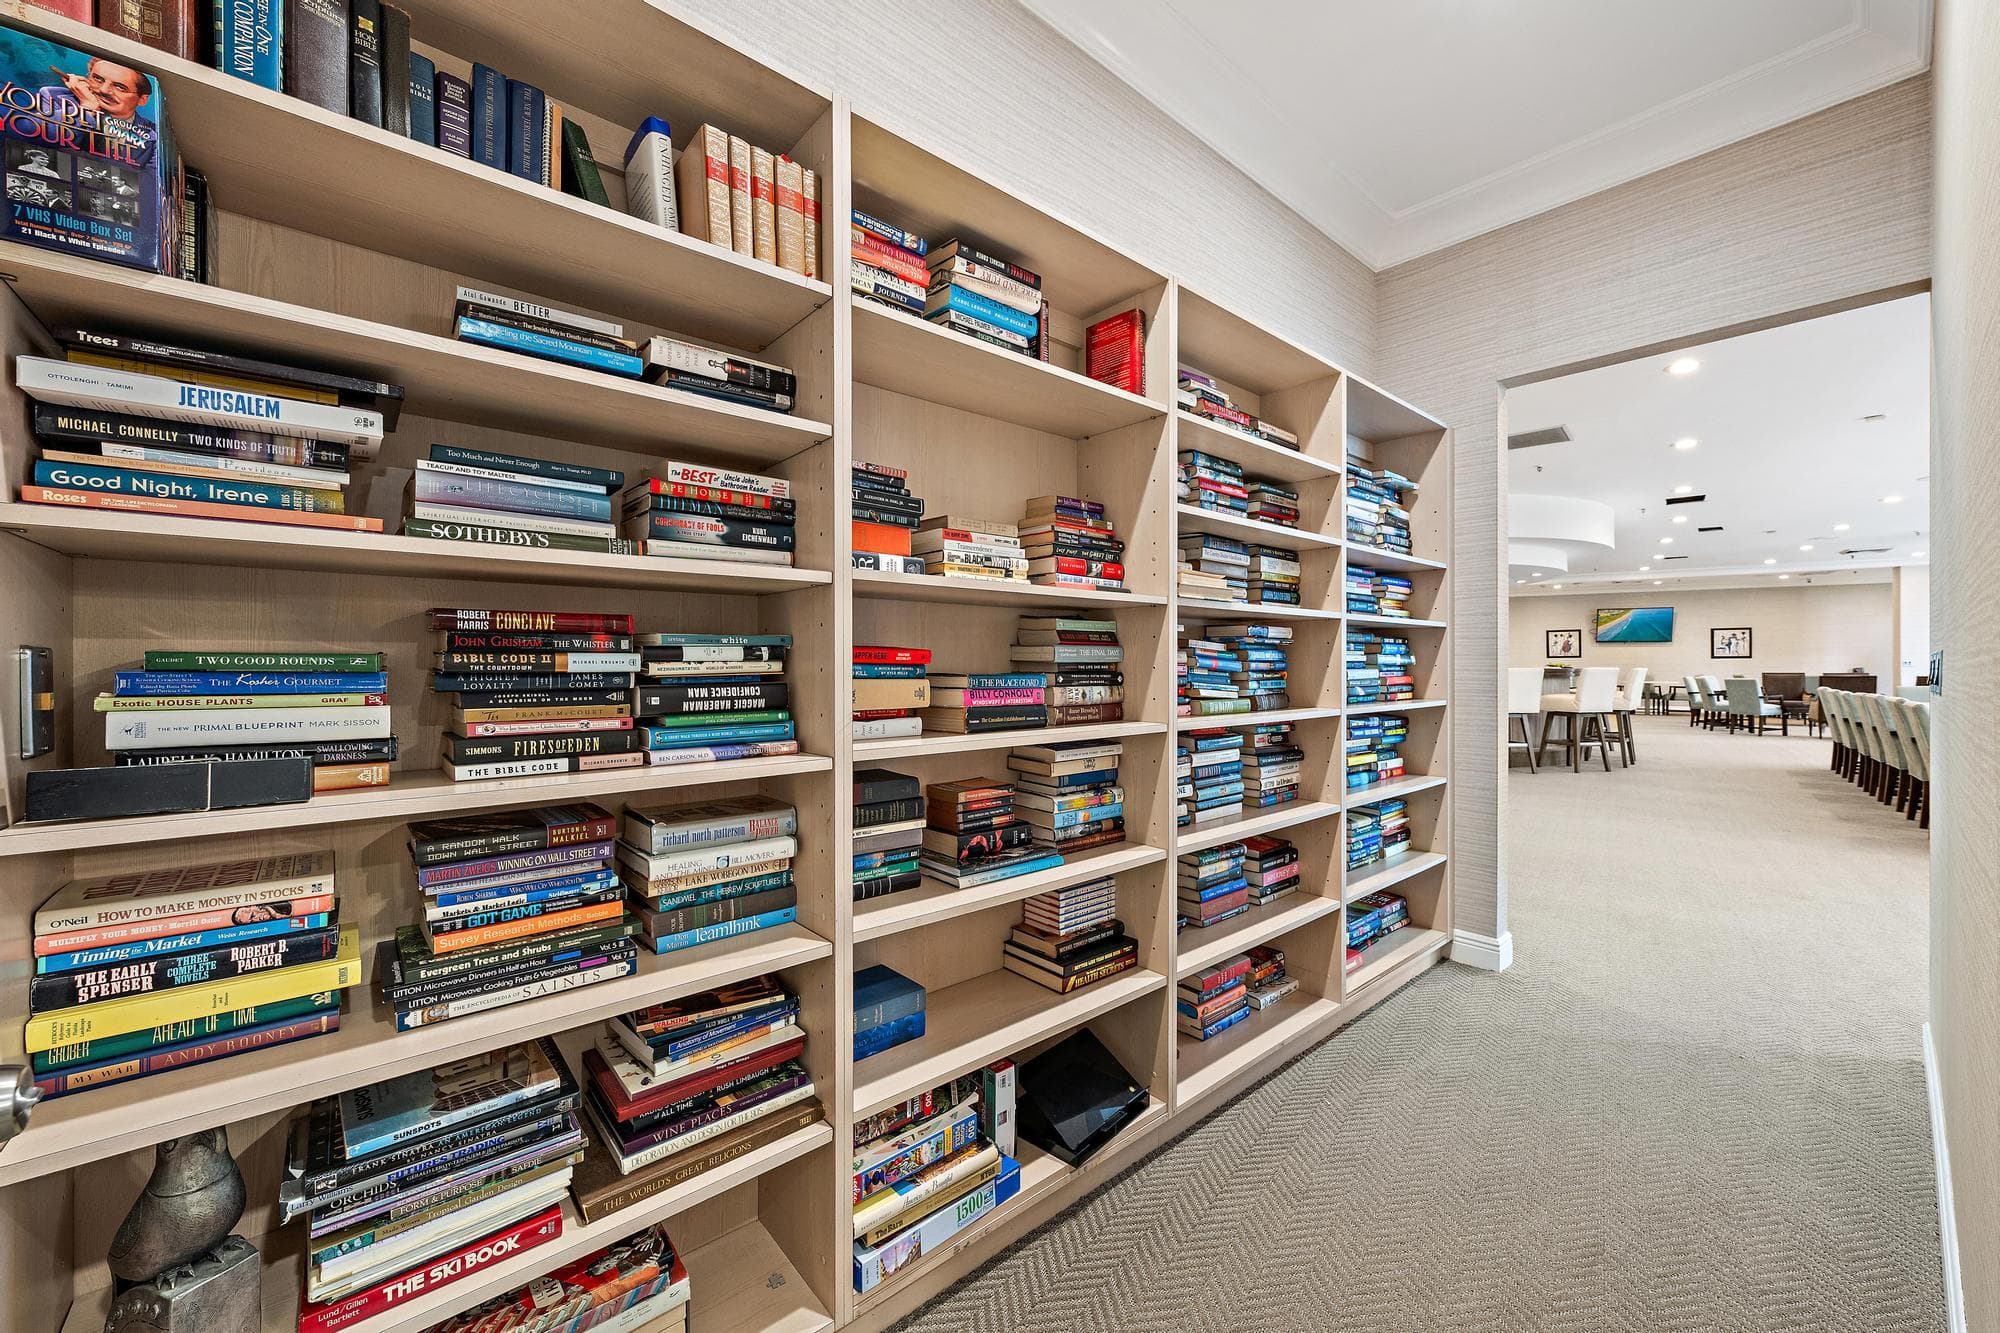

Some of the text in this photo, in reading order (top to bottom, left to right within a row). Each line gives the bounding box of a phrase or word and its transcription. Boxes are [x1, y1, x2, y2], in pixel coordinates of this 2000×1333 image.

[234, 1, 254, 76] COMPANION
[354, 30, 378, 44] HOLY
[0, 82, 104, 131] YOU BET
[105, 116, 151, 140] GROUCHO
[109, 126, 146, 149] MARX
[658, 137, 672, 203] UNHINGED
[13, 203, 133, 243] 7 VHS Video Box Set
[854, 211, 903, 238] BLOCKBUSTER
[864, 237, 925, 269] PRIMARY COLORS
[865, 265, 908, 288] POWELL
[879, 286, 908, 304] JOURNEY
[954, 296, 970, 307] CAROL
[513, 301, 550, 319] BETTER
[57, 416, 297, 458] MICHAEL CONNELLY TWO KINDS OF TRUTH
[447, 449, 540, 470] Too Much and Never Enough
[426, 462, 517, 480] TEACUP AND TOY MALTESE
[671, 469, 680, 477] The
[681, 468, 717, 484] BEST
[724, 472, 759, 487] Uncle John's
[42, 489, 87, 505] Roses
[50, 469, 269, 505] Good Night, Irene
[661, 480, 728, 500] APE HOUSE
[720, 480, 769, 495] Bathroom Reader
[431, 524, 549, 548] SOTHEBY'S
[964, 553, 985, 567] BLACK
[457, 609, 490, 620] ROBERT
[457, 620, 489, 631] HARRIS
[453, 634, 615, 649] JOHN GRISHAM THE WHISTLER
[721, 636, 748, 645] white
[155, 655, 335, 667] GAUDET TWO GOOD ROUNDS
[452, 653, 552, 664] BIBLE CODE II
[463, 682, 513, 690] LOYALTY
[569, 681, 605, 689] COMEY
[688, 686, 760, 698] CONFIDENCE MAN
[979, 678, 993, 688] THE
[996, 678, 1018, 688] PALACE
[112, 696, 349, 708] Exotic HOUSE PLANTS GRAF
[970, 688, 1034, 700] BILLY CONNOLLY
[682, 698, 765, 712] MAGGIE HABERMAN
[316, 742, 373, 754] SWALLOWING
[323, 751, 367, 762] DARKNESS
[662, 825, 746, 847] richard north patterson
[427, 840, 540, 861] DOWN WALL STREET
[686, 862, 769, 887] LAKE WOBEGON DAYS
[50, 885, 304, 930] O'Neil HOW TO MAKE MONEY IN STOCKS
[467, 903, 543, 929] GOT GAME
[439, 909, 609, 949] Survey Research Methods Babbie
[176, 953, 209, 967] THREE
[230, 938, 289, 962] ROBERT B.
[167, 960, 217, 978] COMPLETE
[238, 954, 282, 974] PARKER
[420, 944, 552, 979] Evergreen Trees and Shrubs
[75, 961, 158, 989] THE EARLY
[174, 970, 209, 985] NOVELS
[78, 975, 154, 1004] SPENSER
[408, 994, 438, 1009] LITTON
[440, 986, 482, 1001] Microwave
[484, 978, 513, 993] Cooking
[515, 973, 532, 985] Fruits
[539, 963, 578, 977] Vegetables
[653, 1016, 689, 1029] WALKING
[676, 1023, 737, 1050] Anatomy of Movement
[73, 1025, 298, 1086] MY WAR ANDY ROONEY
[716, 1067, 769, 1093] RUSH LIMBAUGH
[393, 1119, 442, 1141] SUNSPOTS
[652, 1105, 733, 1143] WINE PLACES
[387, 1135, 505, 1183] FUTURES TRADING
[330, 1181, 398, 1210] ORCHIDS
[956, 1190, 984, 1223] 1500
[383, 1233, 521, 1303] THE SKI BOOK
[326, 1308, 361, 1328] Bartlett
